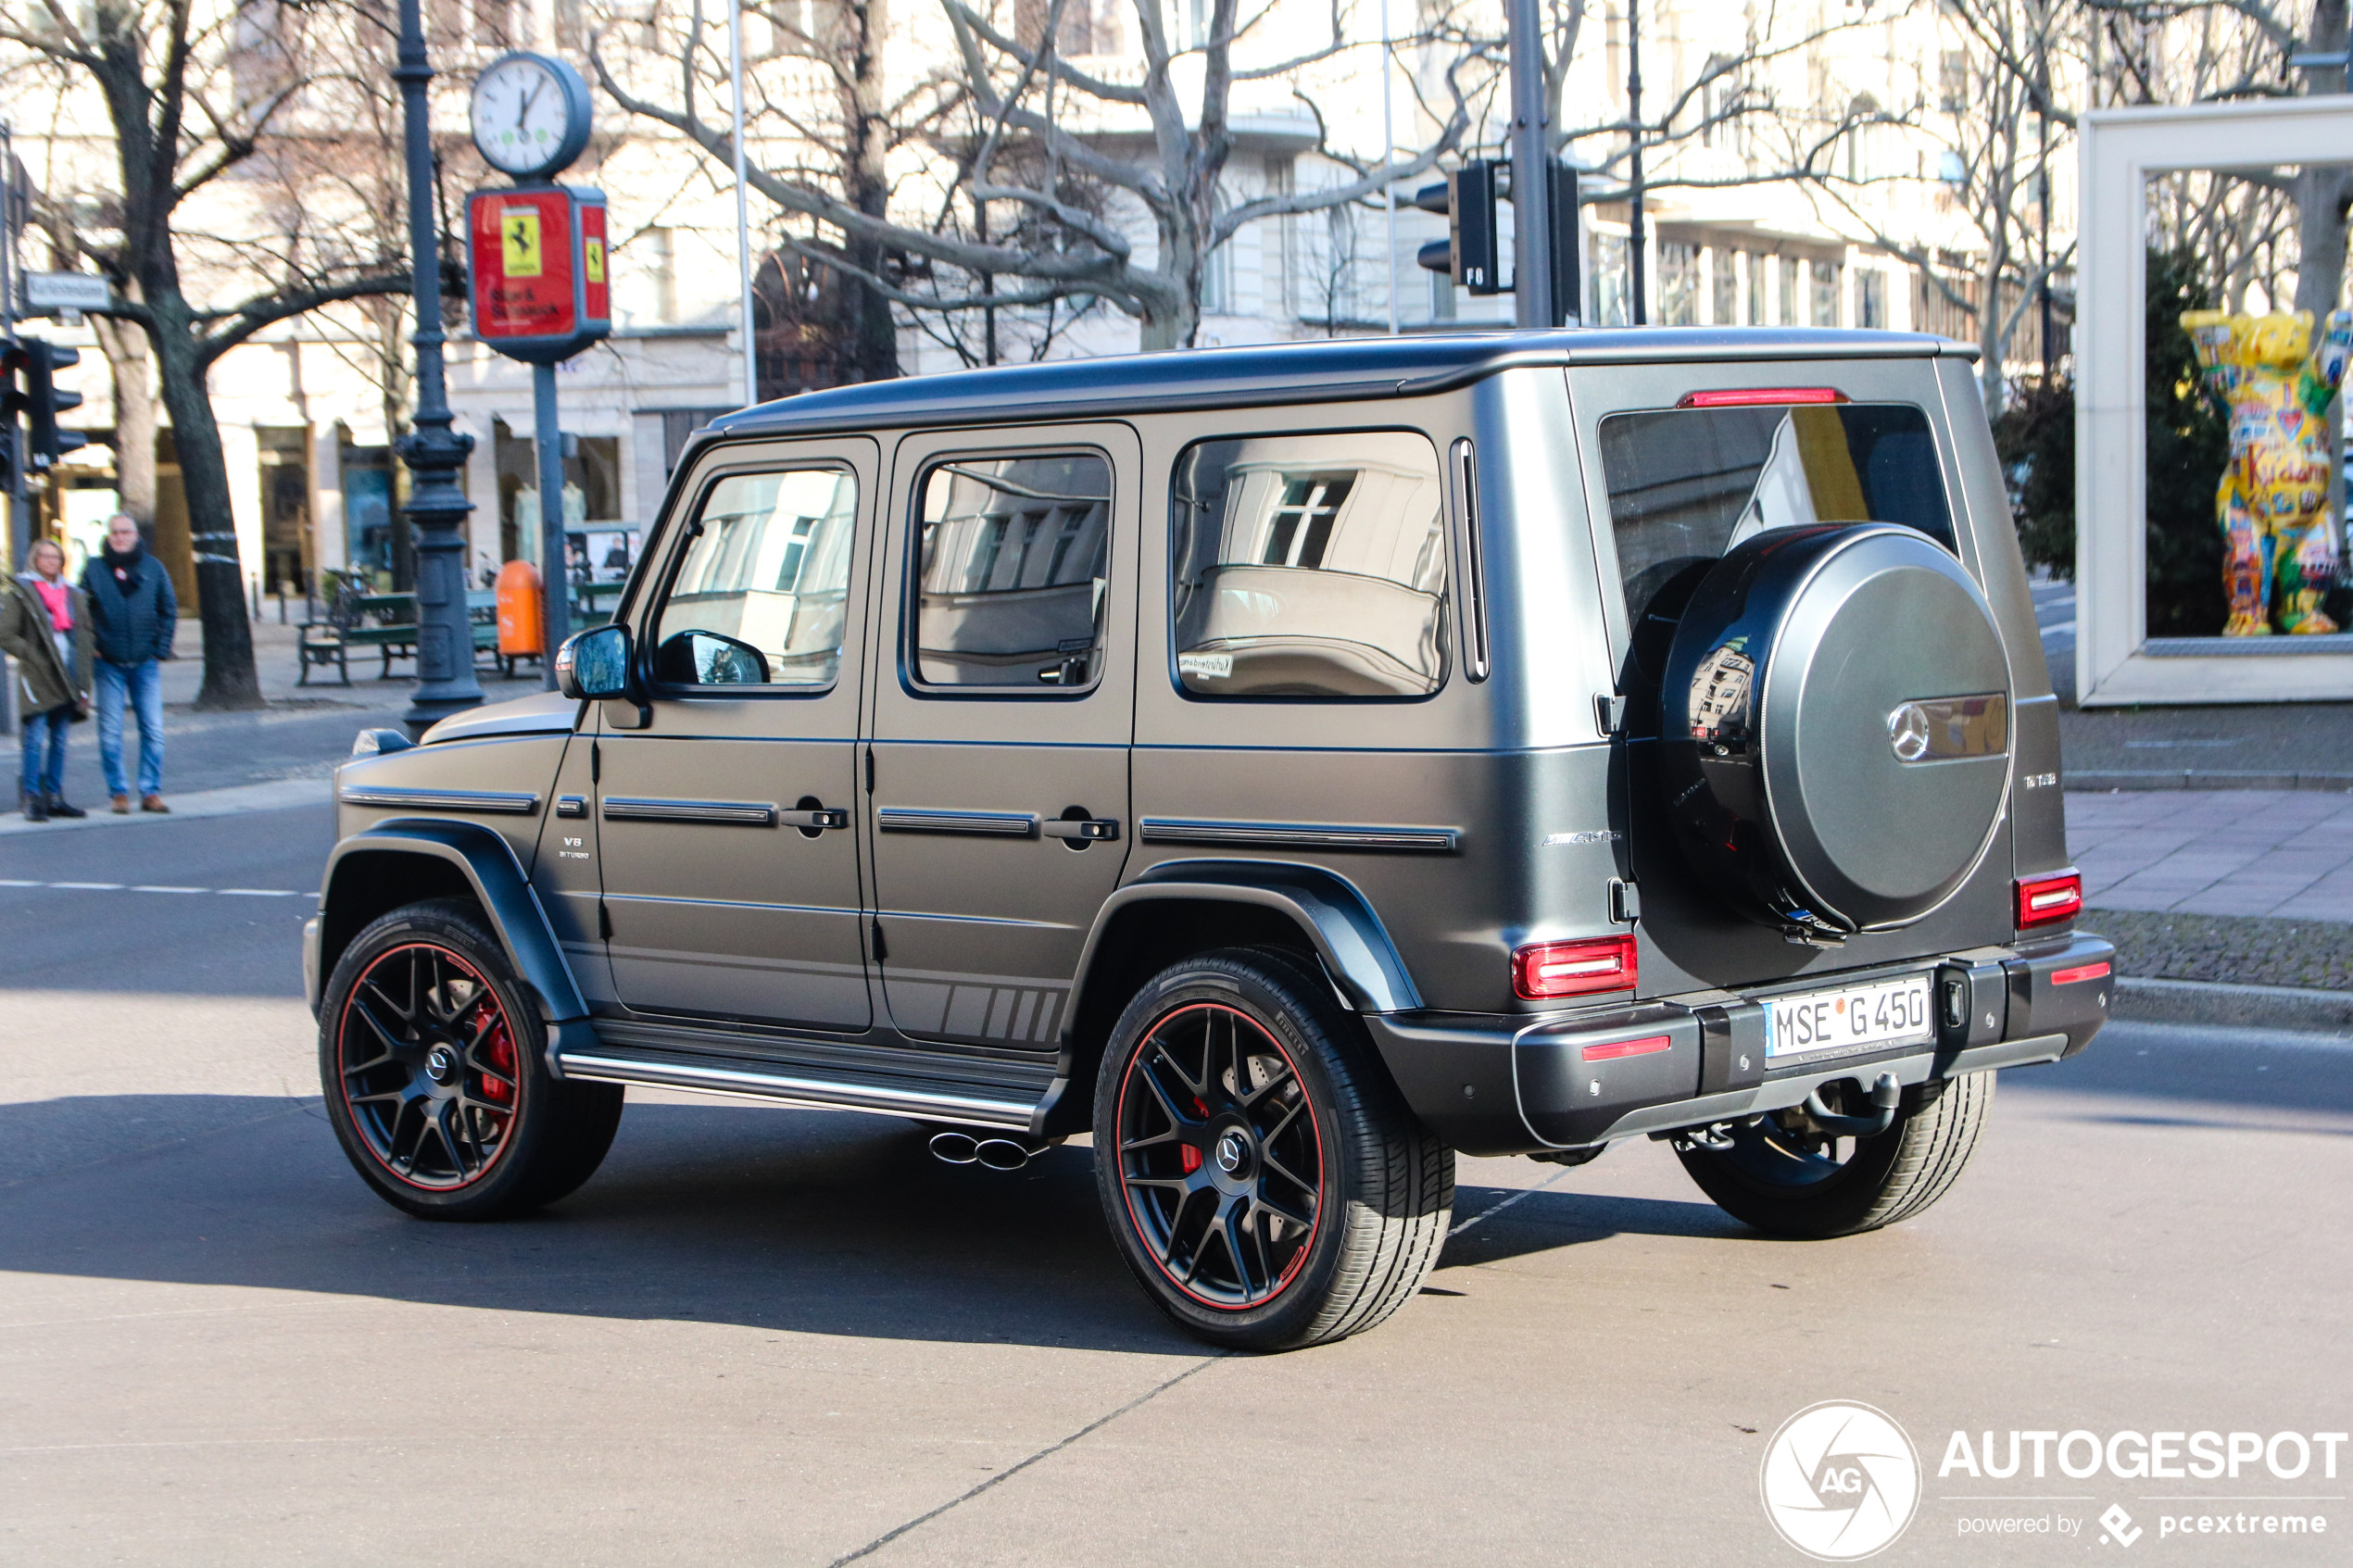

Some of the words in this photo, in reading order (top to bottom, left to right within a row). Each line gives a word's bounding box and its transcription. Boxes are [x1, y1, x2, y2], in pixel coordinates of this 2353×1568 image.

[563, 837, 583, 847] V8
[1275, 1010, 1309, 1056] PIRELLI
[1776, 1002, 1831, 1047] MSE
[1850, 997, 1868, 1035] G
[1874, 989, 1924, 1032] 450
